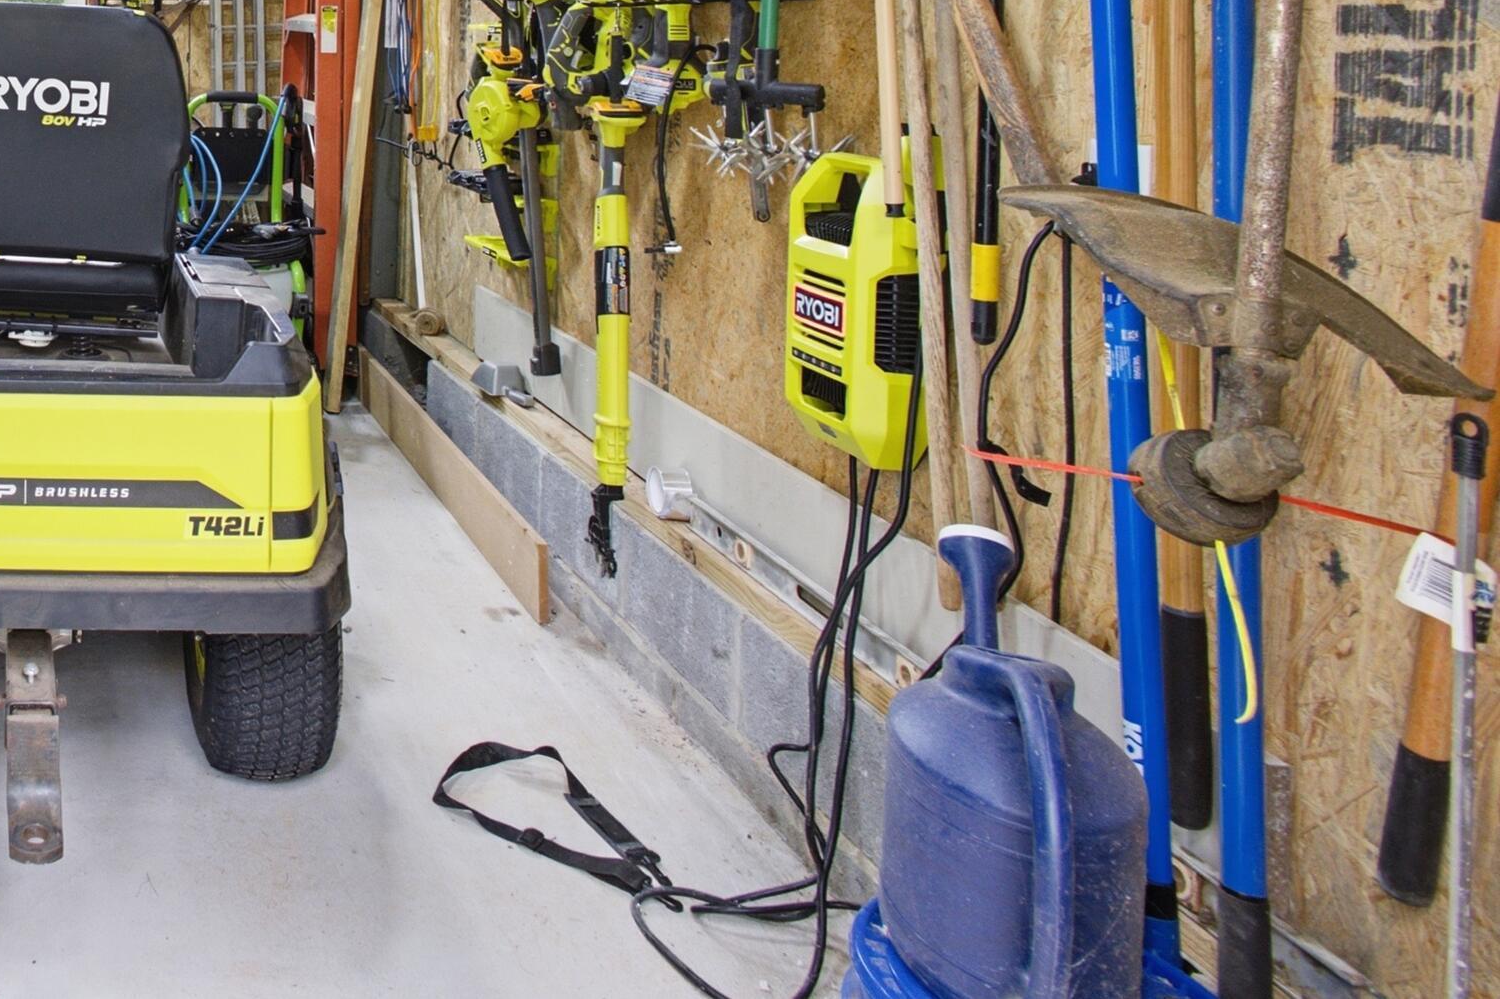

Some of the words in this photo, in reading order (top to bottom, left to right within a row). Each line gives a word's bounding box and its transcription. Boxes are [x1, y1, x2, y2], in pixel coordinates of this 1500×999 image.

[77, 116, 107, 127] HP
[795, 291, 840, 327] RYOBI
[34, 486, 130, 499] BRUSHLESS
[189, 516, 265, 537] T42Li
